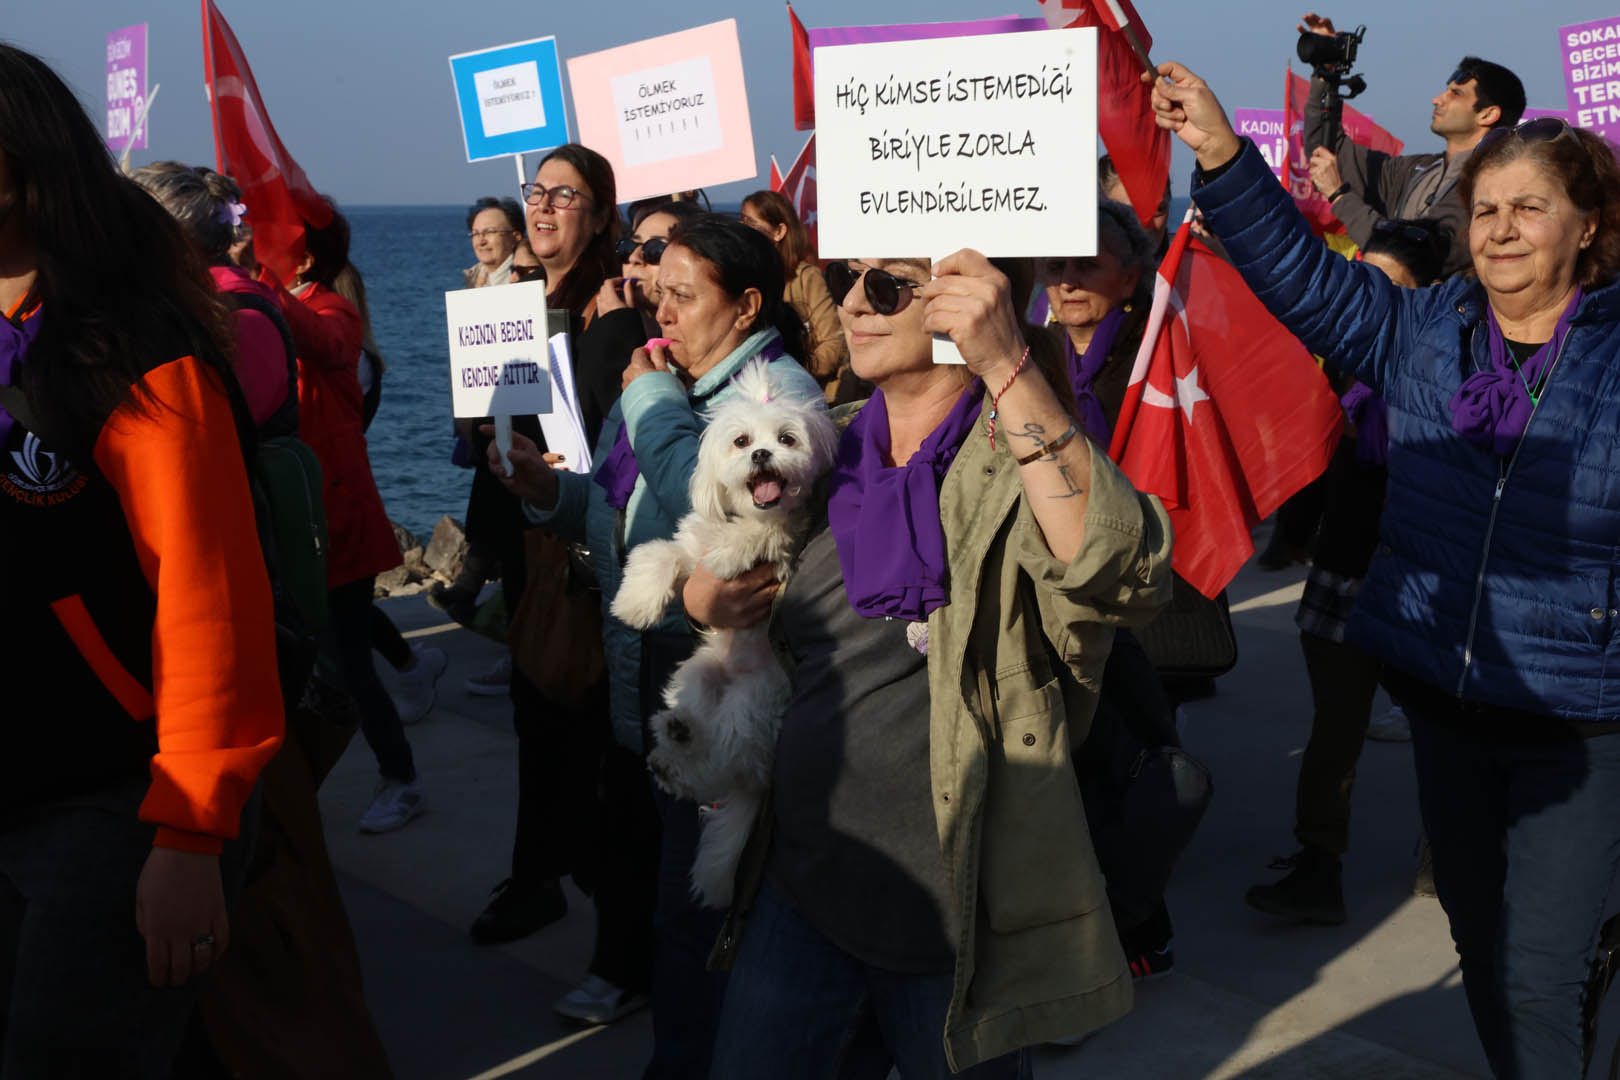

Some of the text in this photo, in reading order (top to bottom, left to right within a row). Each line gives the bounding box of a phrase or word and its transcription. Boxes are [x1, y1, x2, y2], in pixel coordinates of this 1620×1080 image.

[638, 79, 677, 99] ÖLMEK
[836, 62, 1073, 115] HİÇ KİMSE İSTEMEDİĞİ
[623, 93, 705, 122] İSTEMİYORUZ
[1240, 119, 1284, 136] KADIN
[869, 128, 1036, 172] BİRİYLE ZORLA
[860, 181, 1048, 215] EVLENDİRİLEMEZ.
[458, 314, 534, 347] KADININ BEDENİ
[461, 361, 500, 389] KENDİNE
